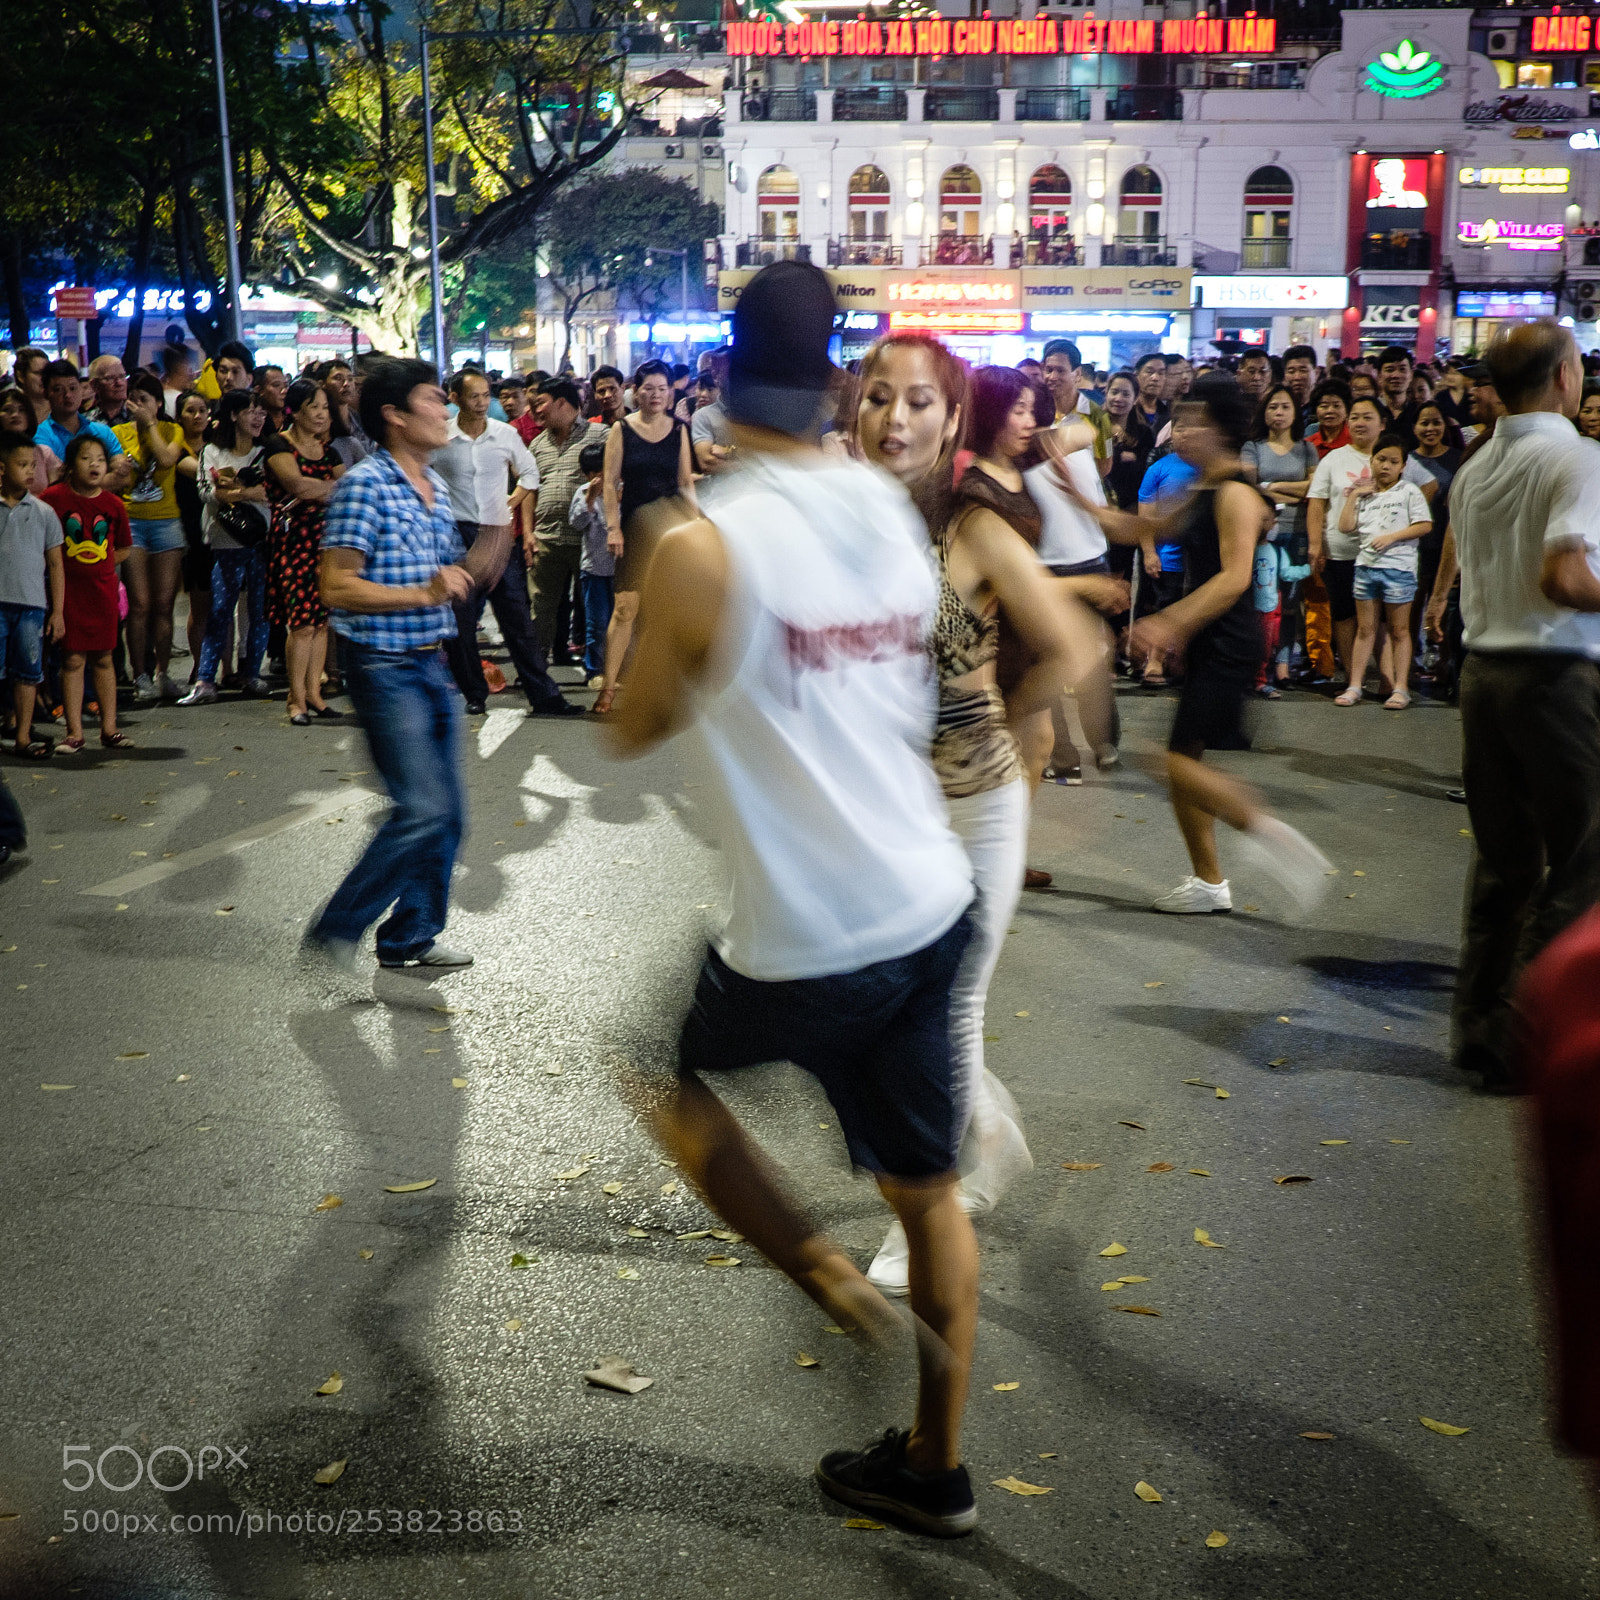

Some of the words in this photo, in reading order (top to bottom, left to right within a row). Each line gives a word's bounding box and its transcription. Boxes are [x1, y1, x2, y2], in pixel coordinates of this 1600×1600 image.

[1107, 20, 1155, 53] NAM
[1498, 221, 1564, 237] VILLAGE
[836, 284, 876, 297] Nikon
[1024, 285, 1074, 296] TAMRON
[1083, 285, 1124, 296] Canon
[1129, 279, 1184, 290] GoPro
[721, 286, 744, 298] SO
[1219, 284, 1275, 301] HSBC
[1363, 304, 1420, 322] KFC
